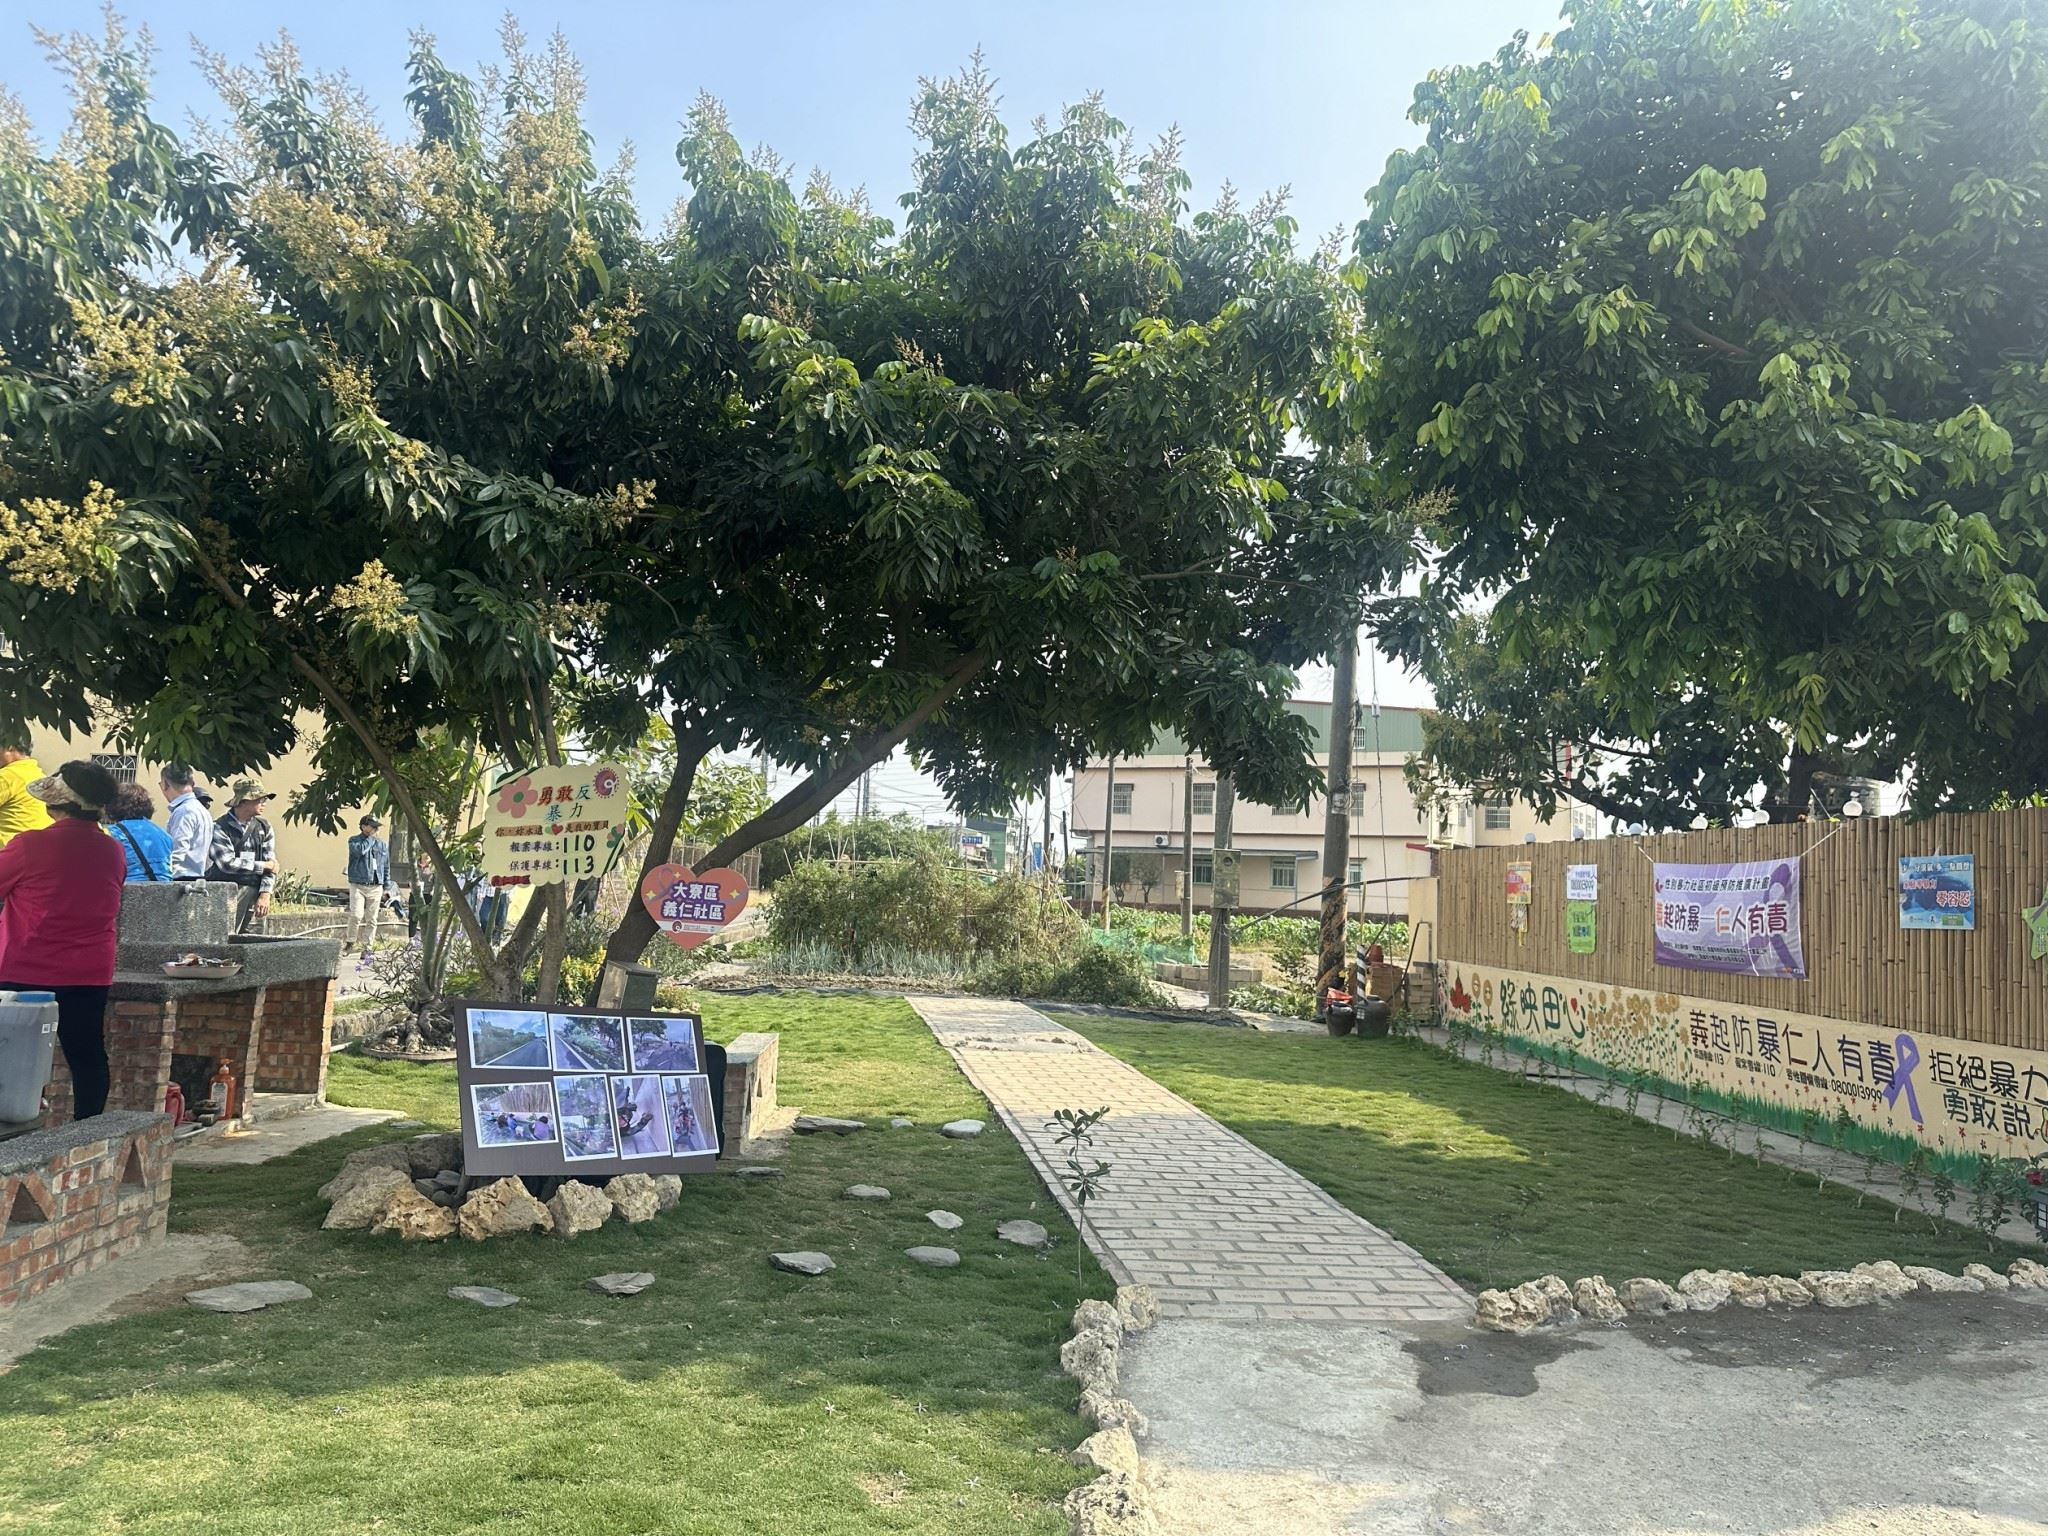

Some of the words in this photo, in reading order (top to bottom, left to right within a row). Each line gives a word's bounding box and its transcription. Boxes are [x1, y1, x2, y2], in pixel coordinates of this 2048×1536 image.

[537, 785, 590, 806] 勇敢反
[545, 803, 583, 821] 暴力
[673, 882, 720, 901] 大寮區
[1936, 890, 1971, 907] 零容忍
[662, 900, 724, 920] 義仁社區
[1690, 1009, 1896, 1089] 義起防暴仁人有責
[1929, 1049, 2048, 1106] 拒絕暴力
[1943, 1088, 2034, 1140] 勇敢說
